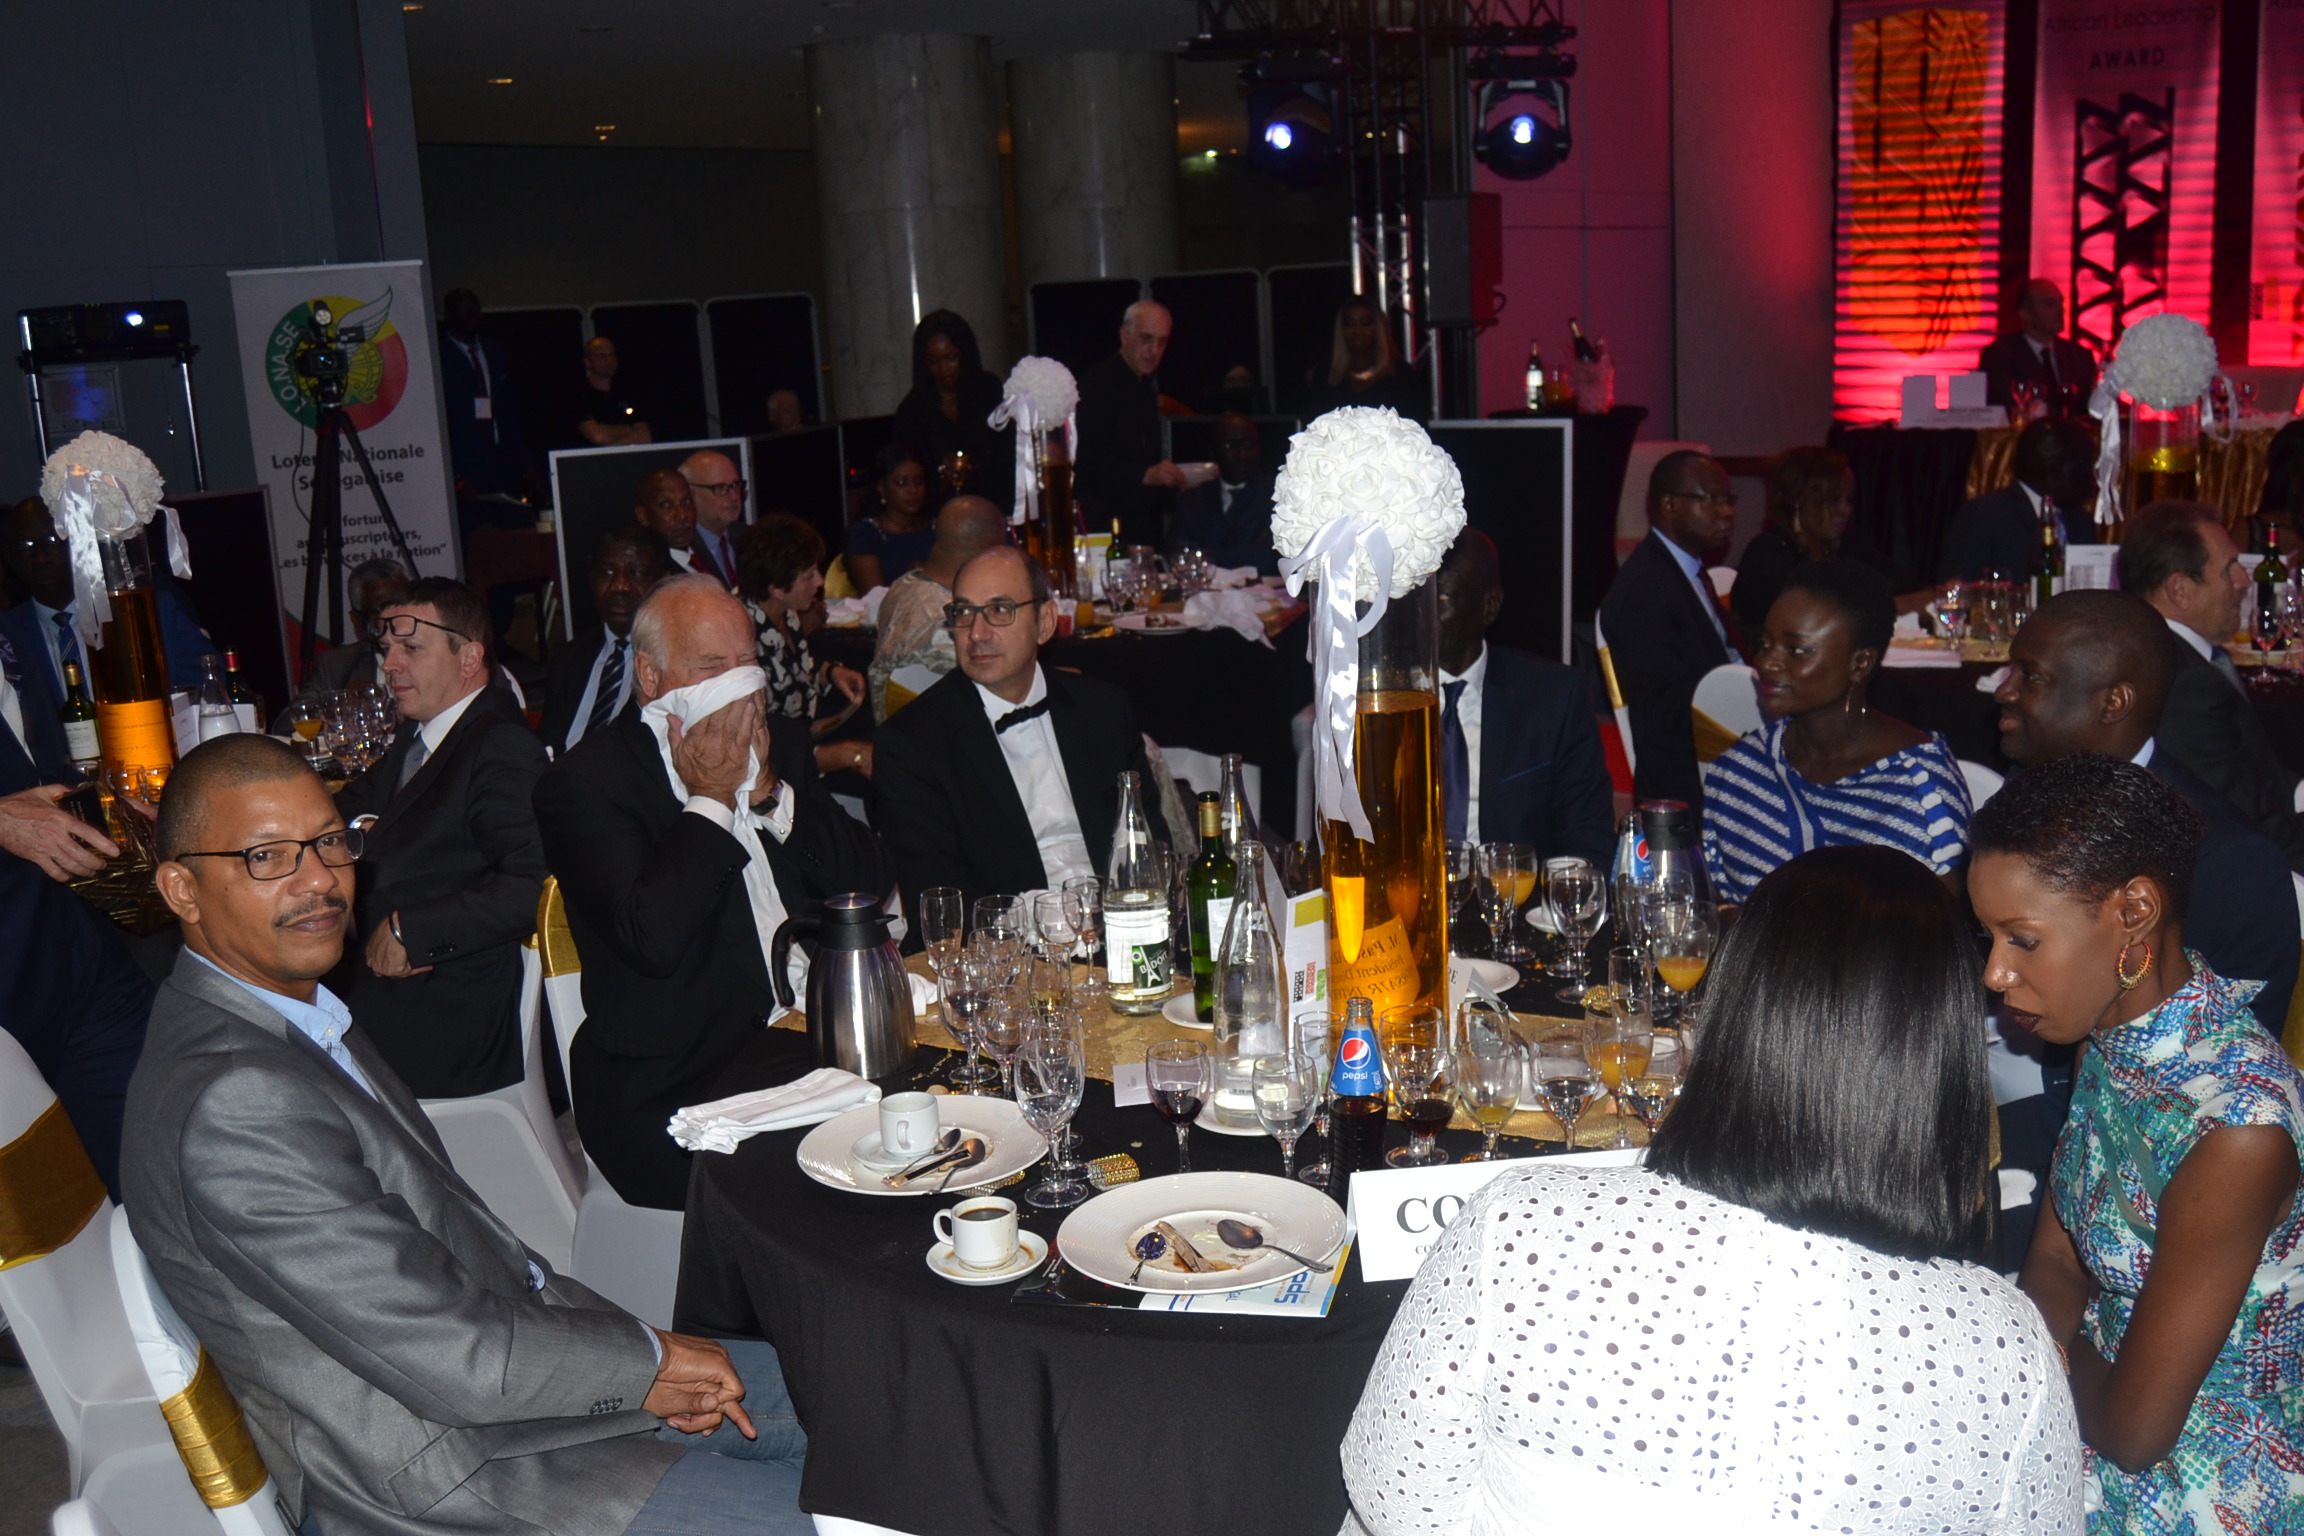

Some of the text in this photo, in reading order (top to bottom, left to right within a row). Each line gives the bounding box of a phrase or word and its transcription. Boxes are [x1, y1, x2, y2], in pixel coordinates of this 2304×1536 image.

[2090, 47, 2165, 69] AWARD
[1342, 1071, 1368, 1081] pepsi
[1396, 1193, 1474, 1233] CO
[1415, 1245, 1433, 1255] CO
